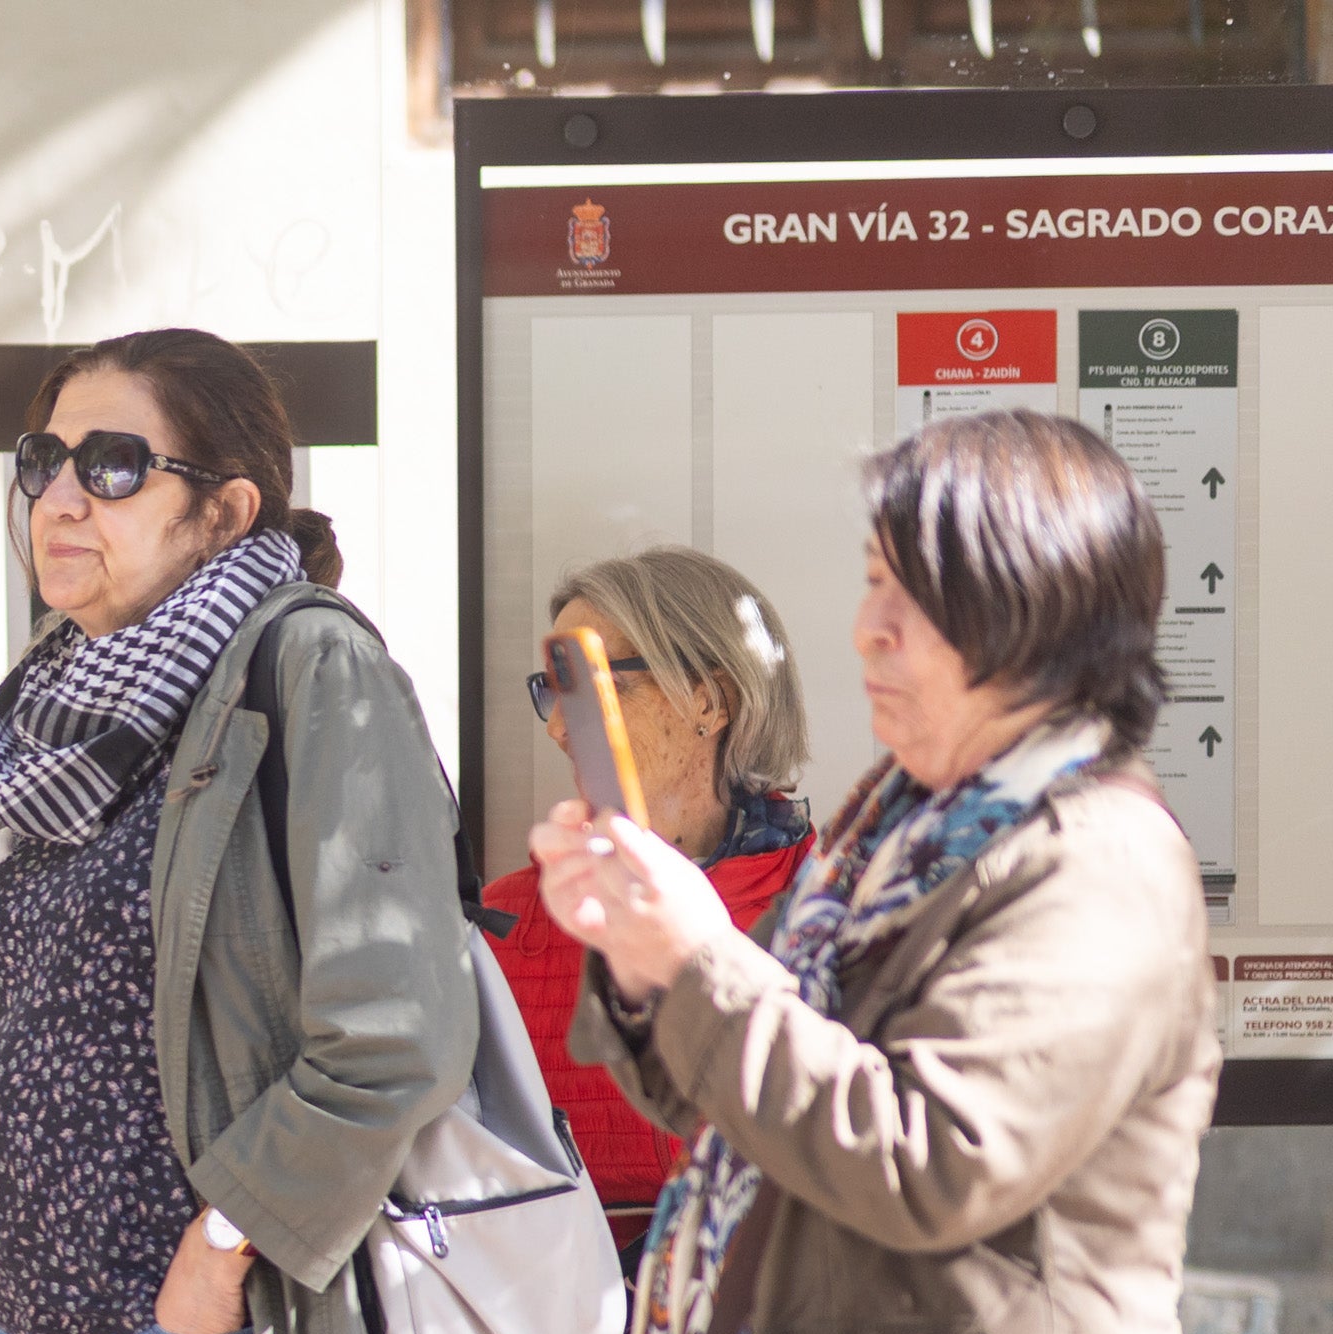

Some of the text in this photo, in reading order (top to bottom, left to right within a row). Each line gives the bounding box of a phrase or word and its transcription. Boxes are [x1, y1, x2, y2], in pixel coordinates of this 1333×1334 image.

[724, 213, 836, 243] GRAN
[849, 203, 917, 242] VÍA
[928, 211, 970, 240] 32
[1005, 207, 1203, 239] SAGRADO
[971, 331, 984, 347] 4
[1153, 331, 1165, 347] 8
[935, 368, 973, 379] CHANA
[983, 364, 1020, 378] ZAIDÍN
[1089, 366, 1104, 375] PTS
[1107, 365, 1138, 376] (DILAR)
[1146, 365, 1183, 375] PALACIO
[1185, 365, 1229, 375] DEPORTES
[1121, 377, 1196, 387] CNO. DE ALFACAR
[1243, 997, 1280, 1005] ACERA
[1283, 996, 1303, 1004] DEL
[1306, 1021, 1323, 1029] 958
